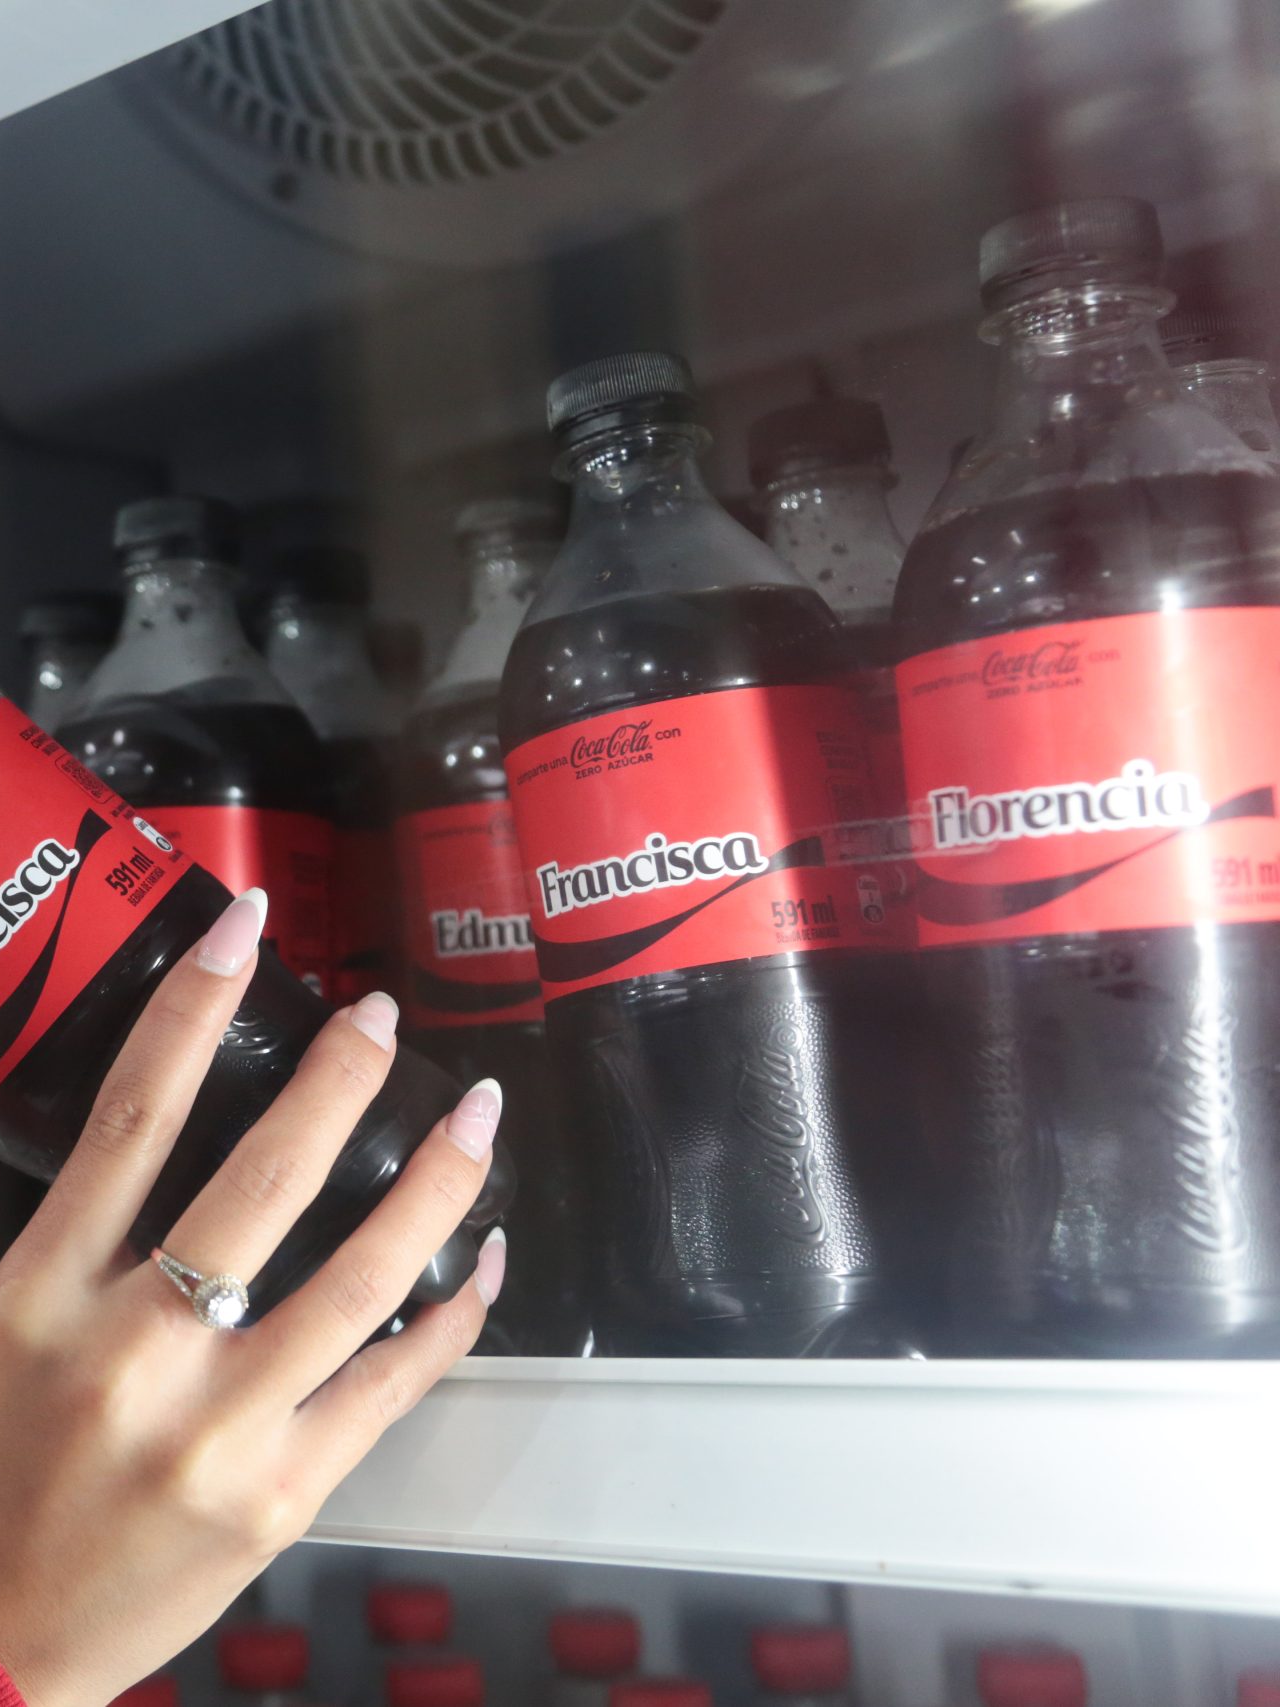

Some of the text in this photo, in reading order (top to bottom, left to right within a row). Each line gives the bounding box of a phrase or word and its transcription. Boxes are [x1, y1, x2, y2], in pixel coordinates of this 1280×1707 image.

[982, 639, 1086, 686] Coca-Cola
[549, 755, 569, 770] una
[570, 719, 654, 768] Coca-Cola
[655, 727, 682, 741] con
[575, 752, 654, 780] ZERO AZÚCAR
[930, 763, 1202, 846] Florencia
[104, 860, 141, 896] 591
[129, 846, 154, 874] ml
[538, 834, 766, 915] Francisca
[770, 894, 838, 928] 591 ml
